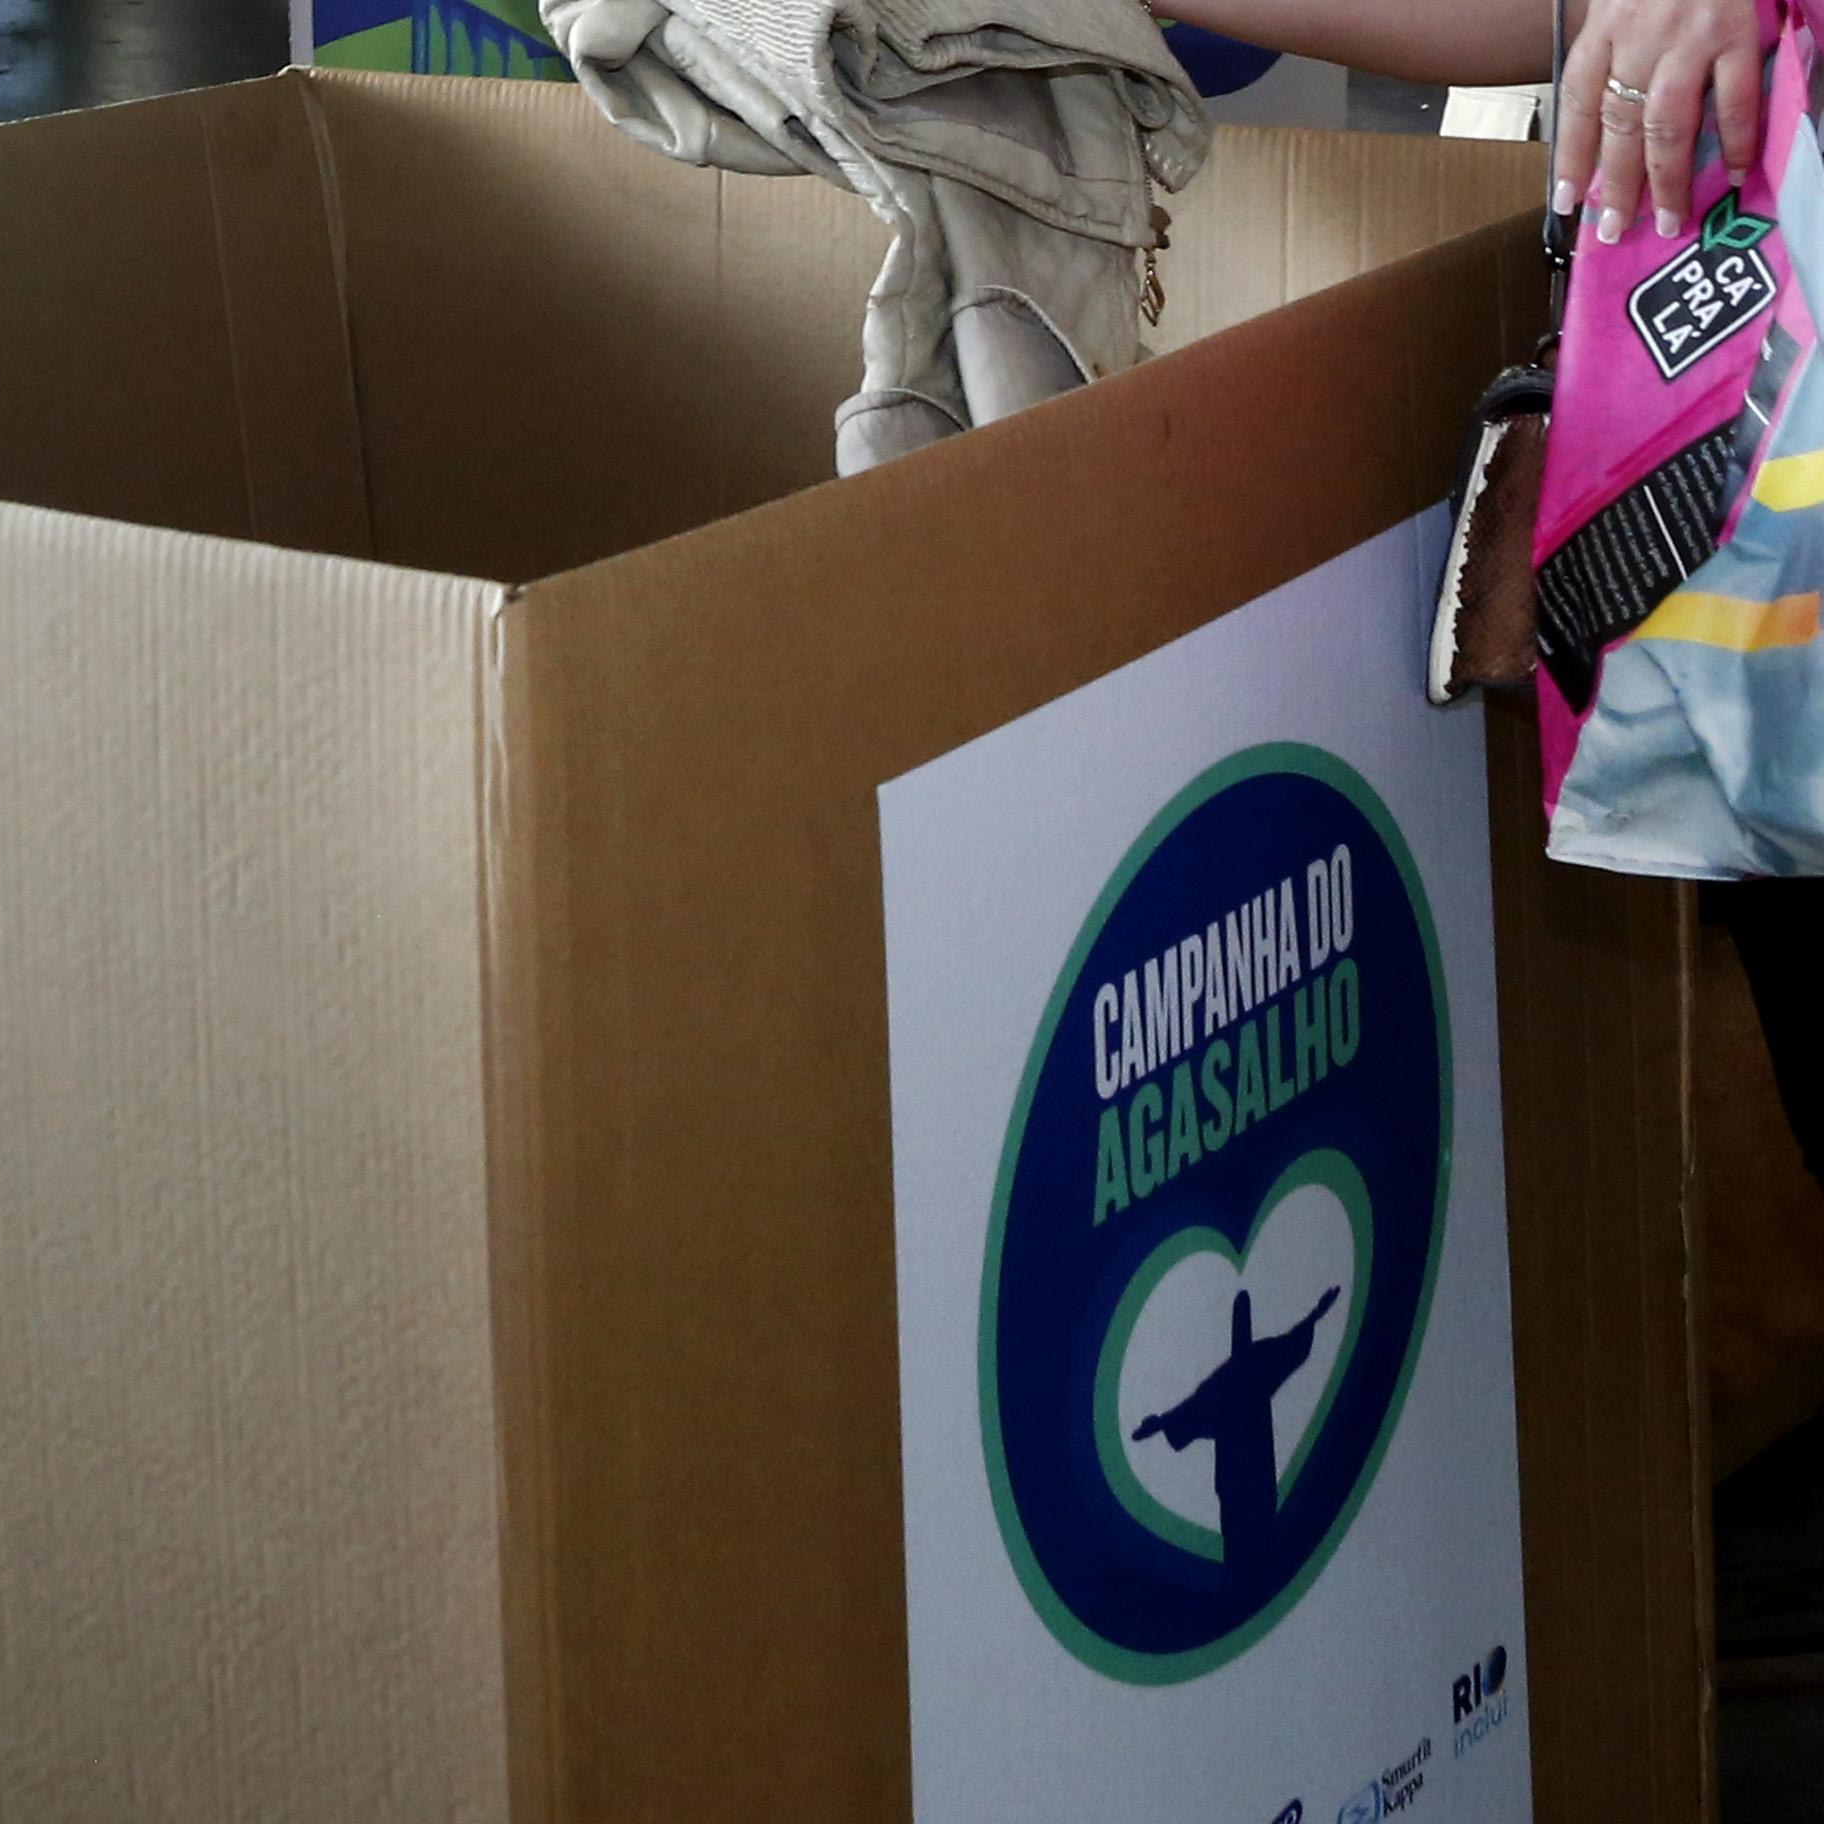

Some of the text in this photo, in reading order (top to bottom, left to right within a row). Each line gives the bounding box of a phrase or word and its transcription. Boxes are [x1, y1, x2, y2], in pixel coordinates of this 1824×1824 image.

[1672, 260, 1724, 330] PRA
[1715, 256, 1762, 307] CÁ
[1652, 301, 1702, 354] LÁ
[1093, 843, 1354, 1100] CAMPANHA DO
[1093, 958, 1361, 1227] AGASALHO
[1452, 1645, 1507, 1724] RIO
